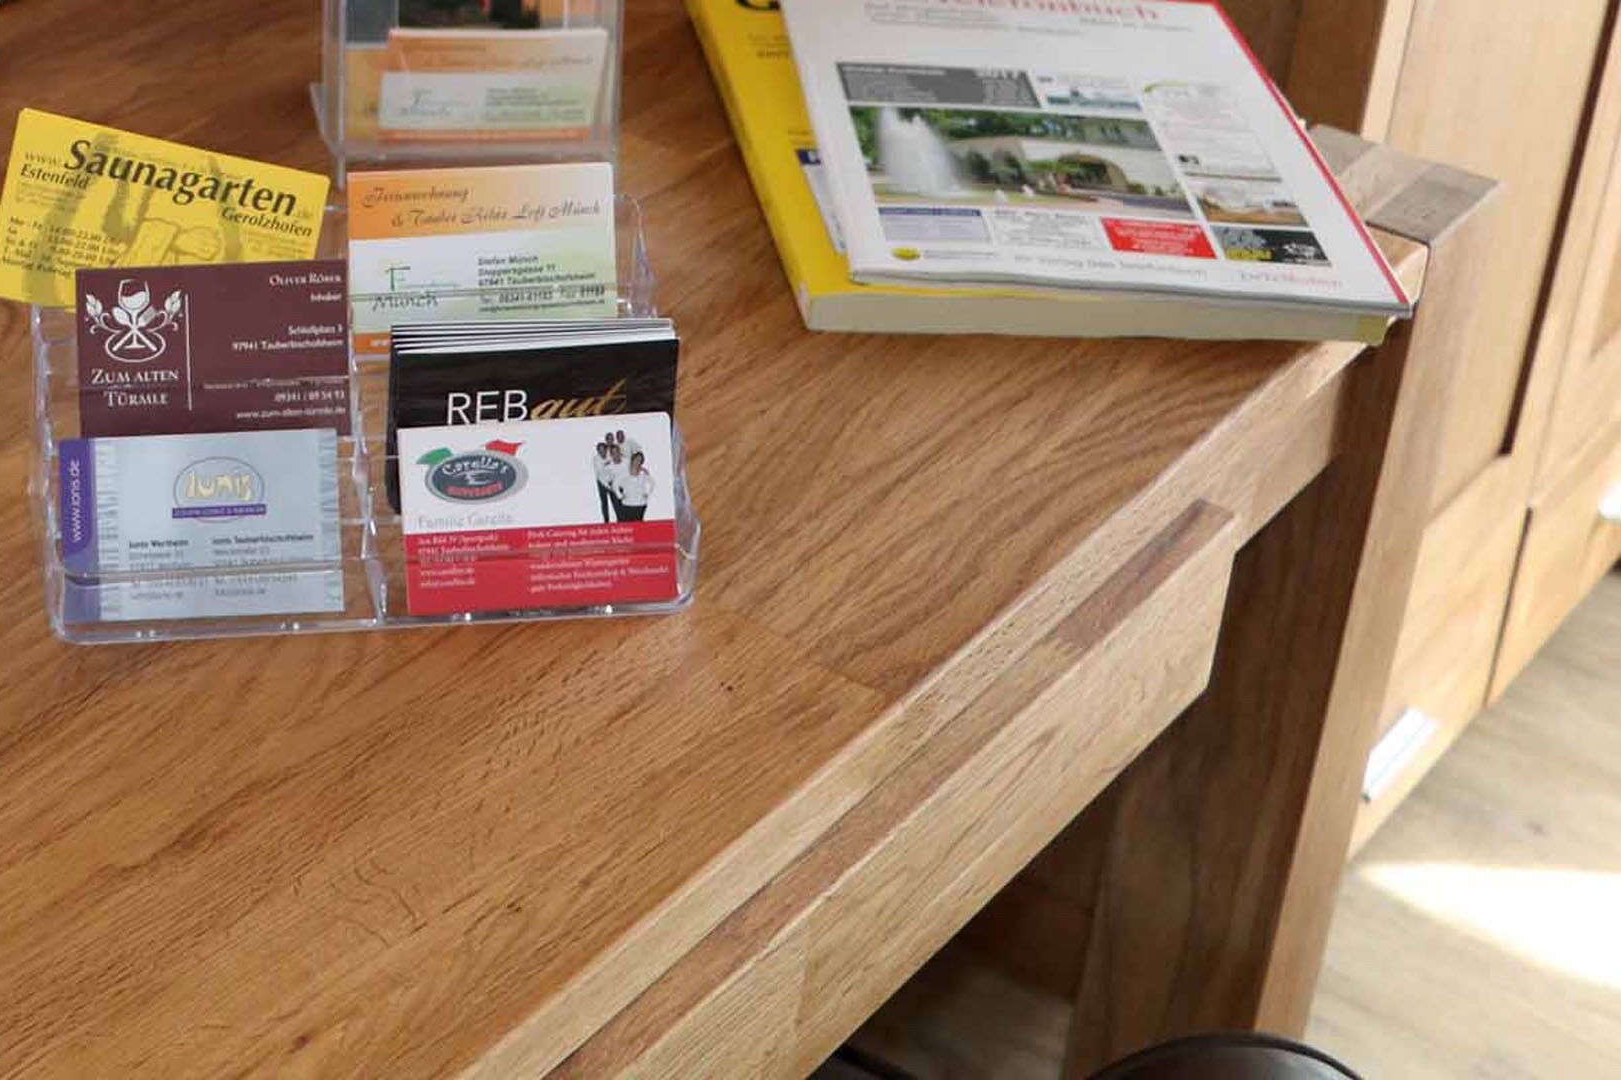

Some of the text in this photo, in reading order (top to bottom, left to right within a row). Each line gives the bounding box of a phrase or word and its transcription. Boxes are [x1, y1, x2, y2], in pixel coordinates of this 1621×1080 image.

[20, 163, 90, 190] Estenfeld
[64, 140, 297, 216] Saunagarten
[222, 206, 313, 238] Gerolzhofen
[91, 368, 179, 386] ZUM ALTEN
[103, 389, 169, 407] TÜRMLE
